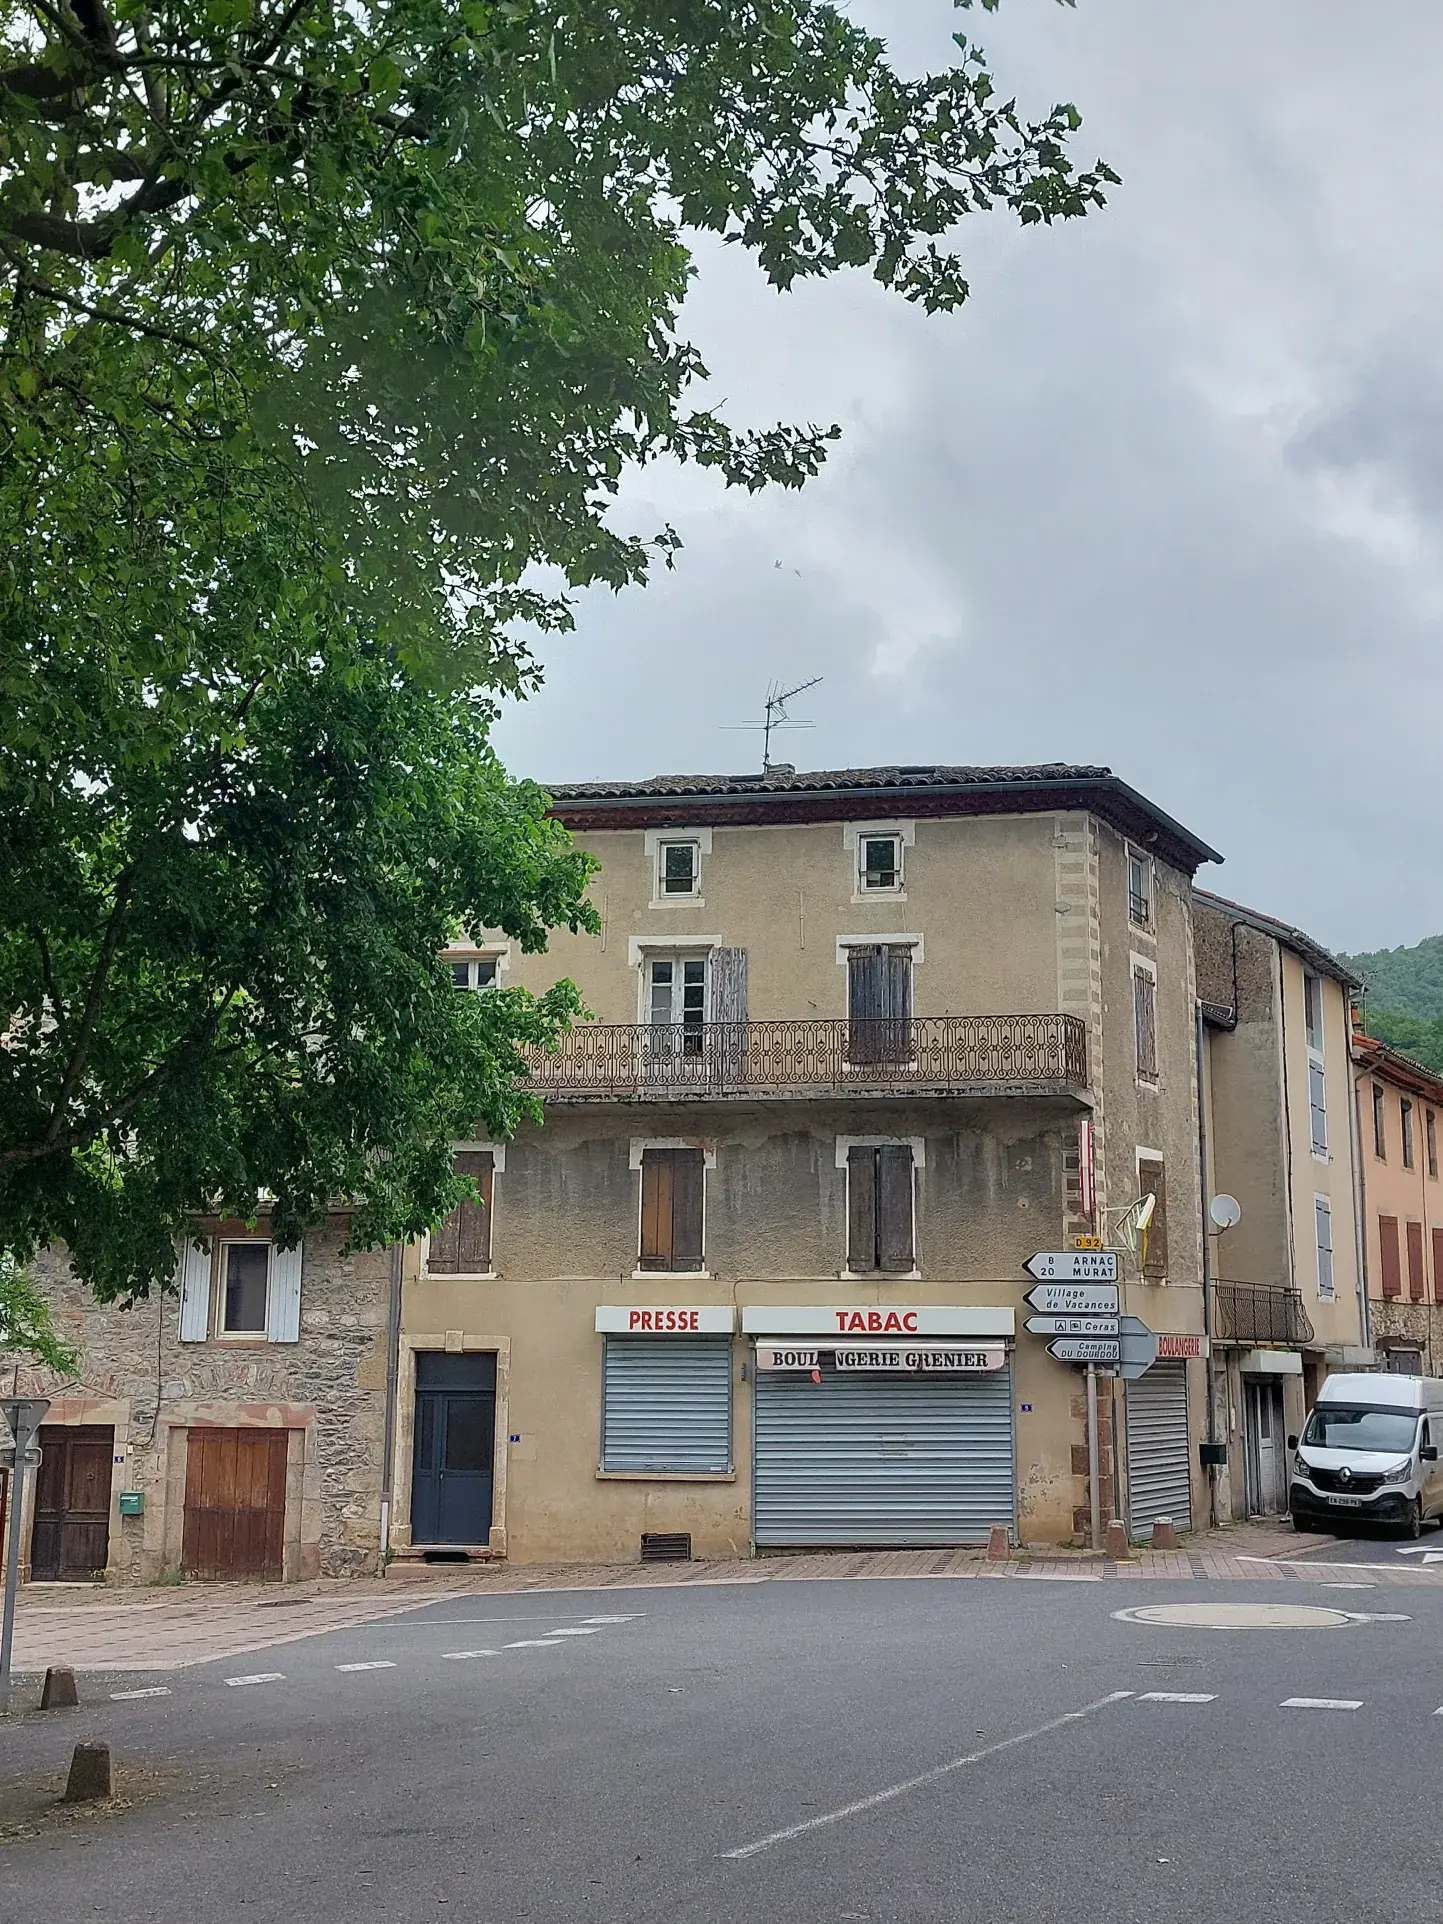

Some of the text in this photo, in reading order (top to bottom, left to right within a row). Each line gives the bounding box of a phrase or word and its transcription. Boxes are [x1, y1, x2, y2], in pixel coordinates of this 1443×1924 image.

[1076, 1239, 1100, 1247] D 92
[1048, 1256, 1113, 1265] 8 ARNAC
[1041, 1268, 1114, 1276] 20 MURAT
[1047, 1288, 1085, 1299] Village
[1046, 1300, 1115, 1309] de Vacances
[629, 1311, 699, 1330] PRESSE
[836, 1312, 918, 1331] TABAC
[1085, 1322, 1115, 1331] Ceras
[1079, 1342, 1118, 1352] Camping
[1159, 1336, 1200, 1356] BOULANGERIE
[1061, 1350, 1072, 1358] DU
[772, 1352, 988, 1367] BOULNGERIE GRENIER
